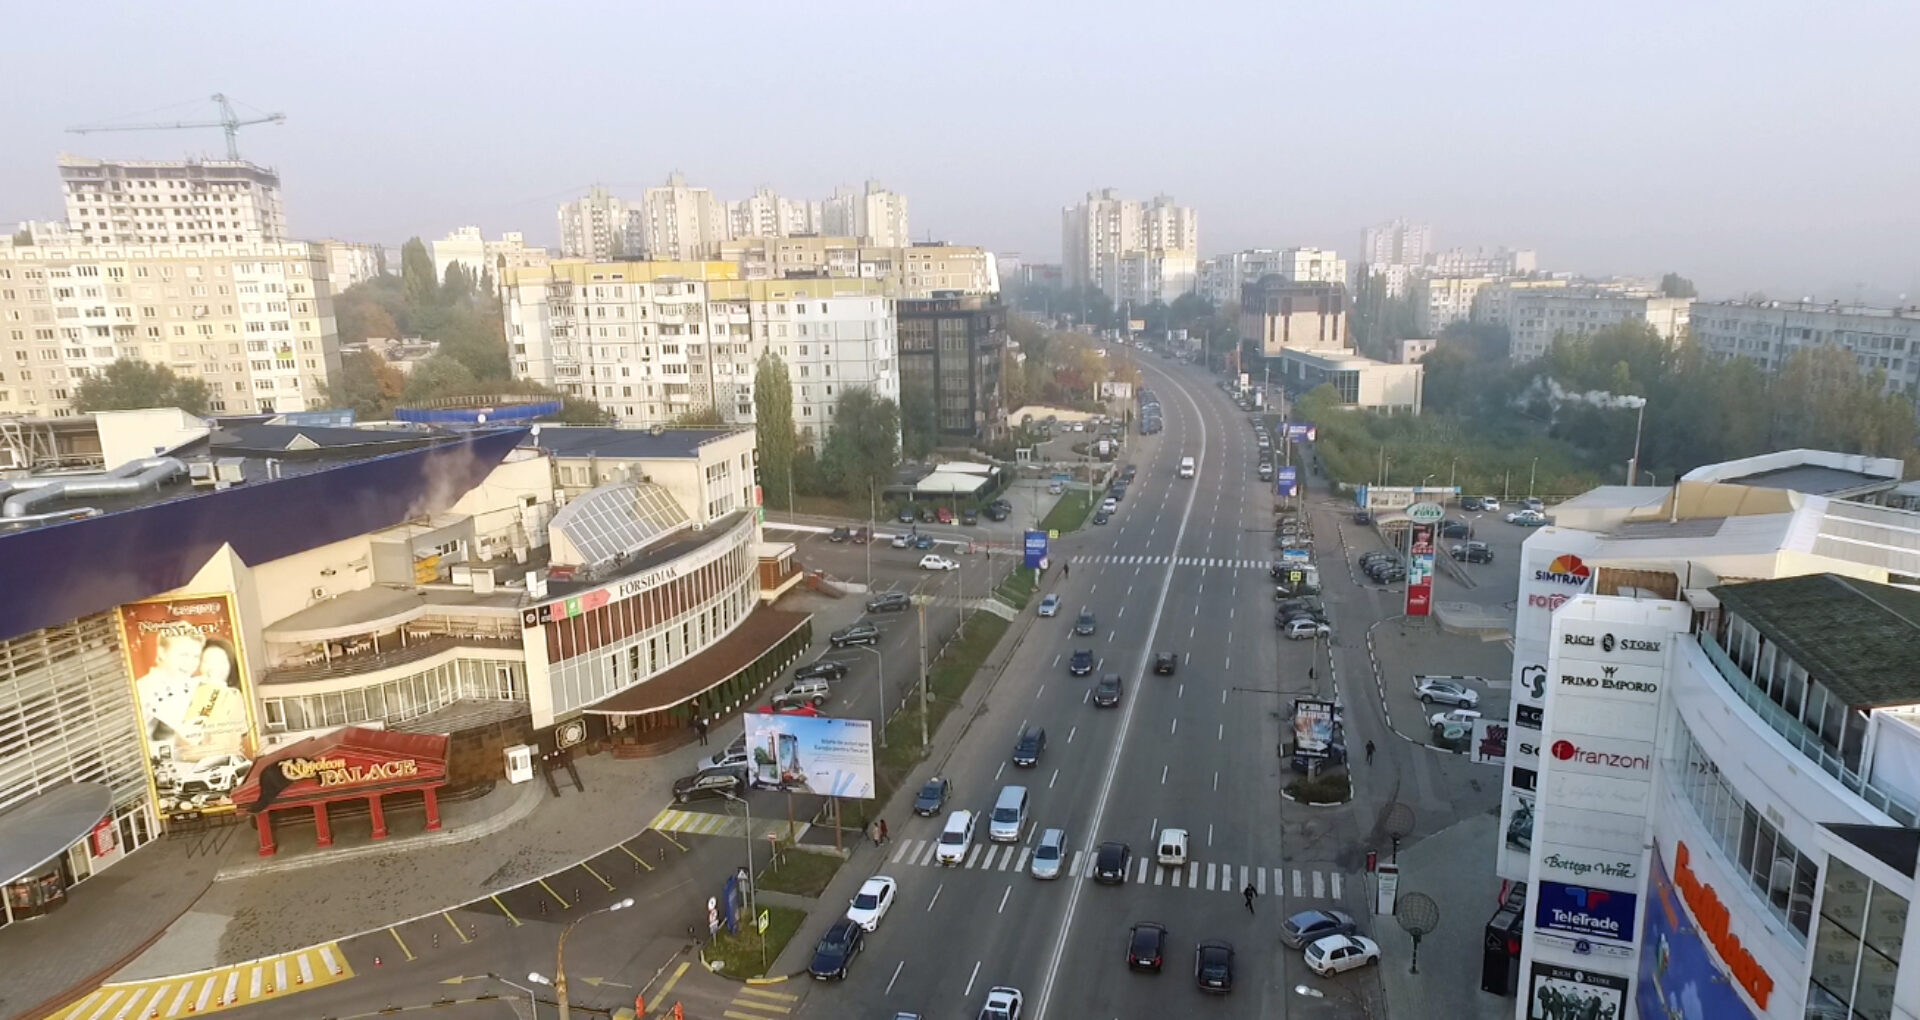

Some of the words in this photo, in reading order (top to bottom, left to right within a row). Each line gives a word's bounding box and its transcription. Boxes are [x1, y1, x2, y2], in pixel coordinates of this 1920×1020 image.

[618, 567, 678, 598] FORSHMAK
[160, 622, 220, 637] PALACE
[1564, 634, 1595, 646] RICH
[1620, 638, 1661, 651] STORY
[1561, 675, 1598, 687] PRIMO
[1601, 679, 1657, 693] EMPORIO
[1574, 747, 1649, 770] franzoni
[279, 757, 346, 780] Napoleon
[319, 759, 417, 787] PALACE
[1544, 853, 1592, 875] Bottega
[1594, 862, 1636, 878] Verde
[1552, 909, 1619, 931] TeleTrade
